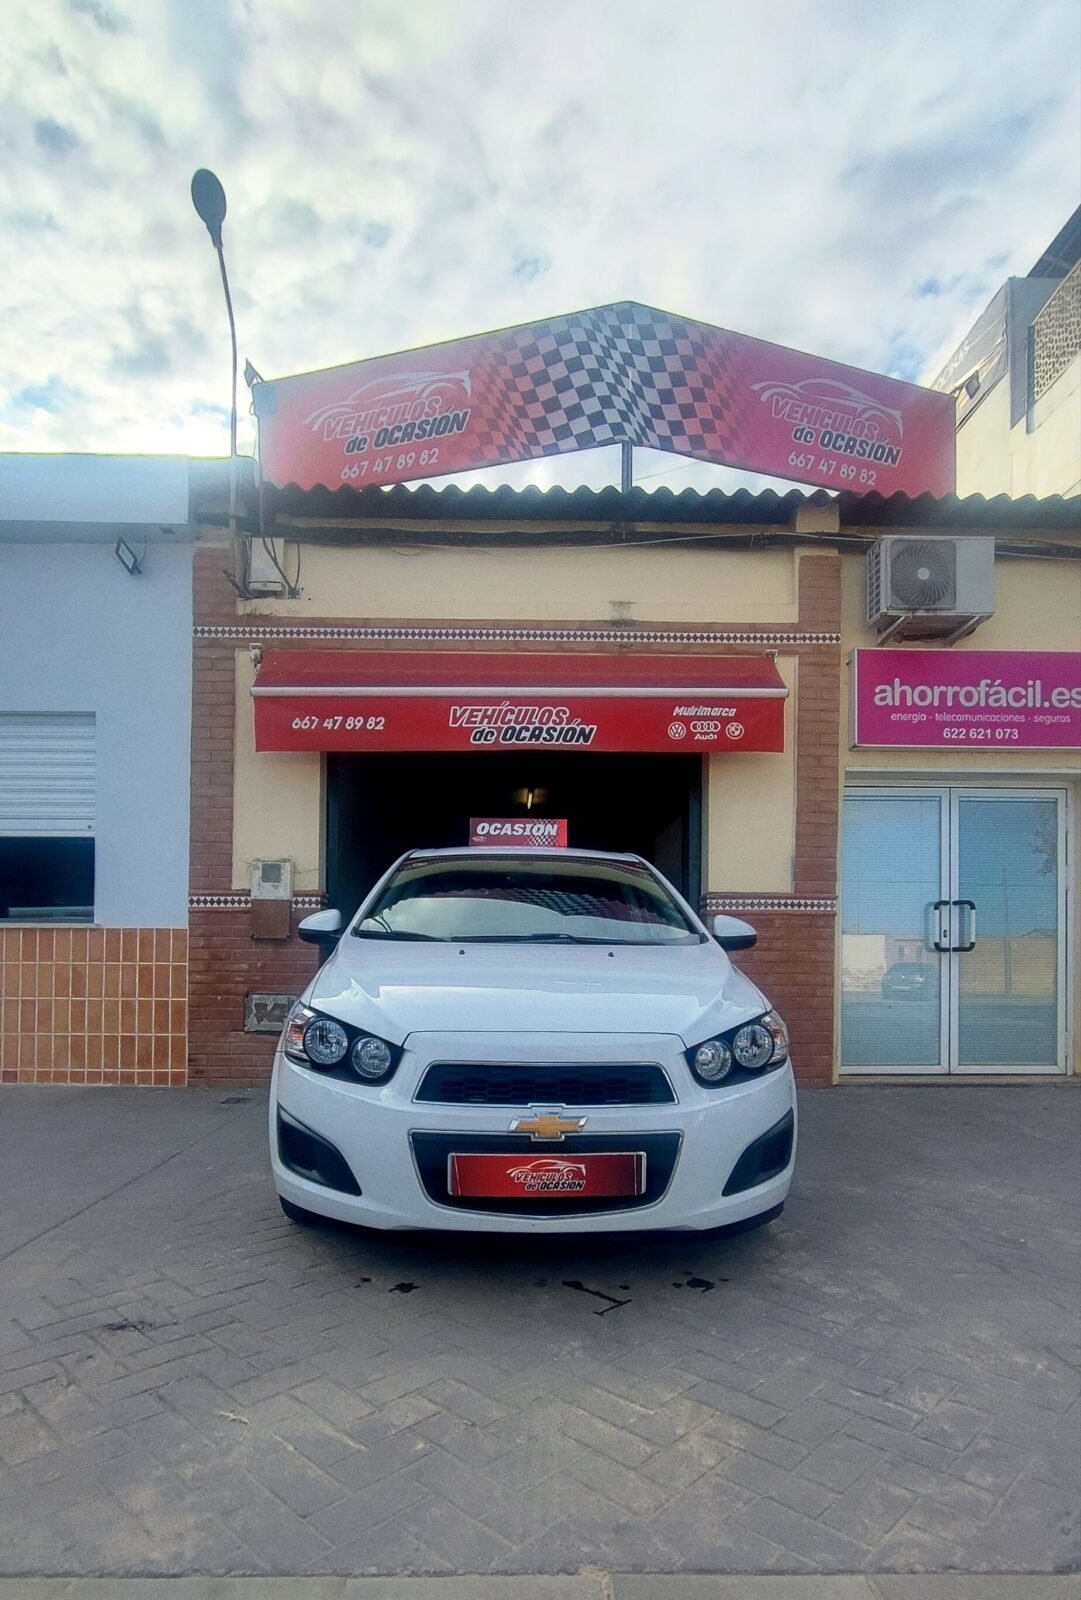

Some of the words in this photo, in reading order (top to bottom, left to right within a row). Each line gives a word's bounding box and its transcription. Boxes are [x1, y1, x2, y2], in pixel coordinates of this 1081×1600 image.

[344, 435, 370, 455] de
[373, 405, 471, 449] OCASIÓN
[792, 425, 815, 445] de
[819, 429, 903, 467] OCASIÓN
[341, 461, 369, 480] 667
[373, 456, 394, 474] 47
[396, 452, 416, 470] 89
[419, 448, 439, 466] 82
[788, 451, 816, 470] 667
[818, 458, 837, 475] 47
[839, 464, 857, 480] 89
[859, 469, 877, 485] 82
[874, 678, 1081, 708] ahorrofácil.es
[292, 716, 318, 729] 667
[323, 716, 343, 729] 47
[345, 716, 364, 730] 89
[366, 716, 385, 730] 82
[449, 701, 570, 727] VEHÍCULOS
[935, 712, 1026, 723] telecomunicaciones
[1034, 715, 1071, 725] seguros
[470, 727, 497, 744] de
[500, 719, 597, 744] OCASIÓN
[943, 728, 967, 739] 622
[969, 728, 992, 739] 621
[995, 728, 1019, 739] 073
[525, 1181, 539, 1191] de
